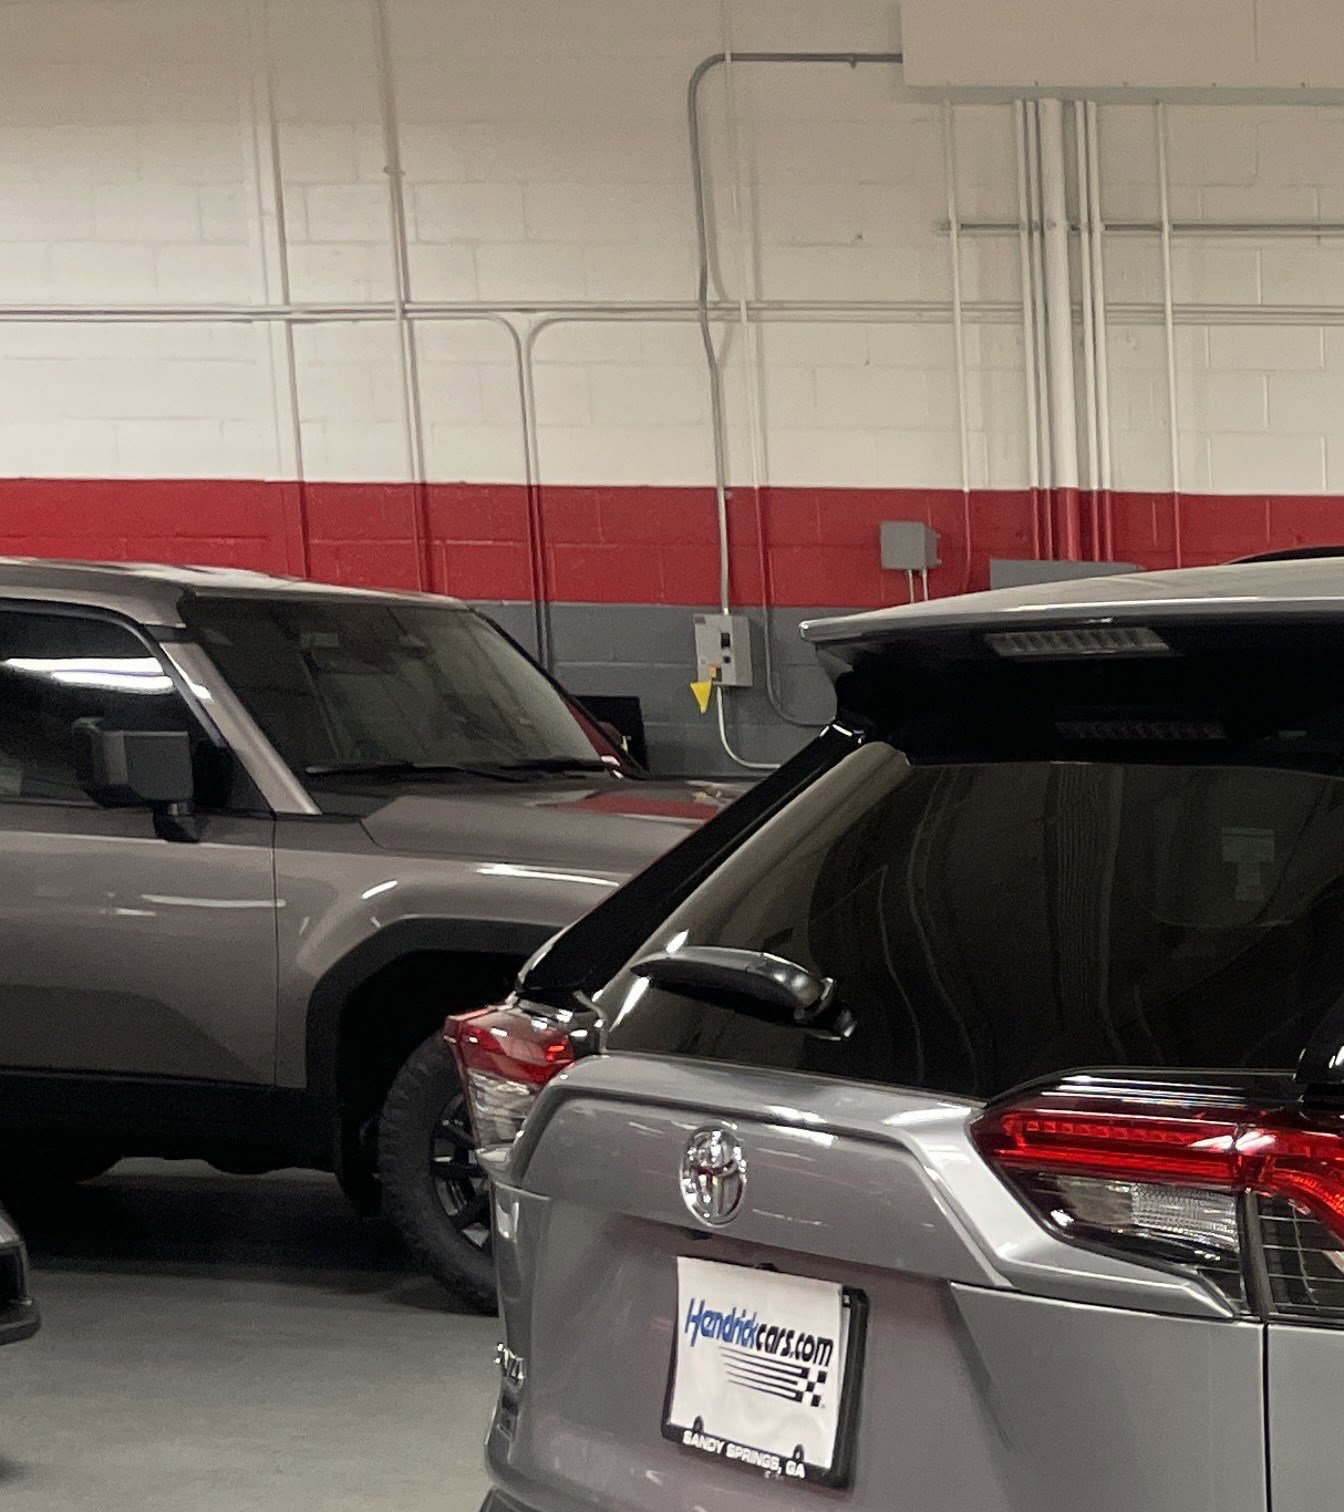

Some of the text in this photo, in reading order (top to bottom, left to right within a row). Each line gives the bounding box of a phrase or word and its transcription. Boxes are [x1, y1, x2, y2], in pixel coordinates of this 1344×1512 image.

[684, 1298, 834, 1367] Hendrickcars.com
[682, 1430, 725, 1454] SANDY
[726, 1443, 782, 1473] SPRINGS,
[785, 1460, 806, 1479] GA
